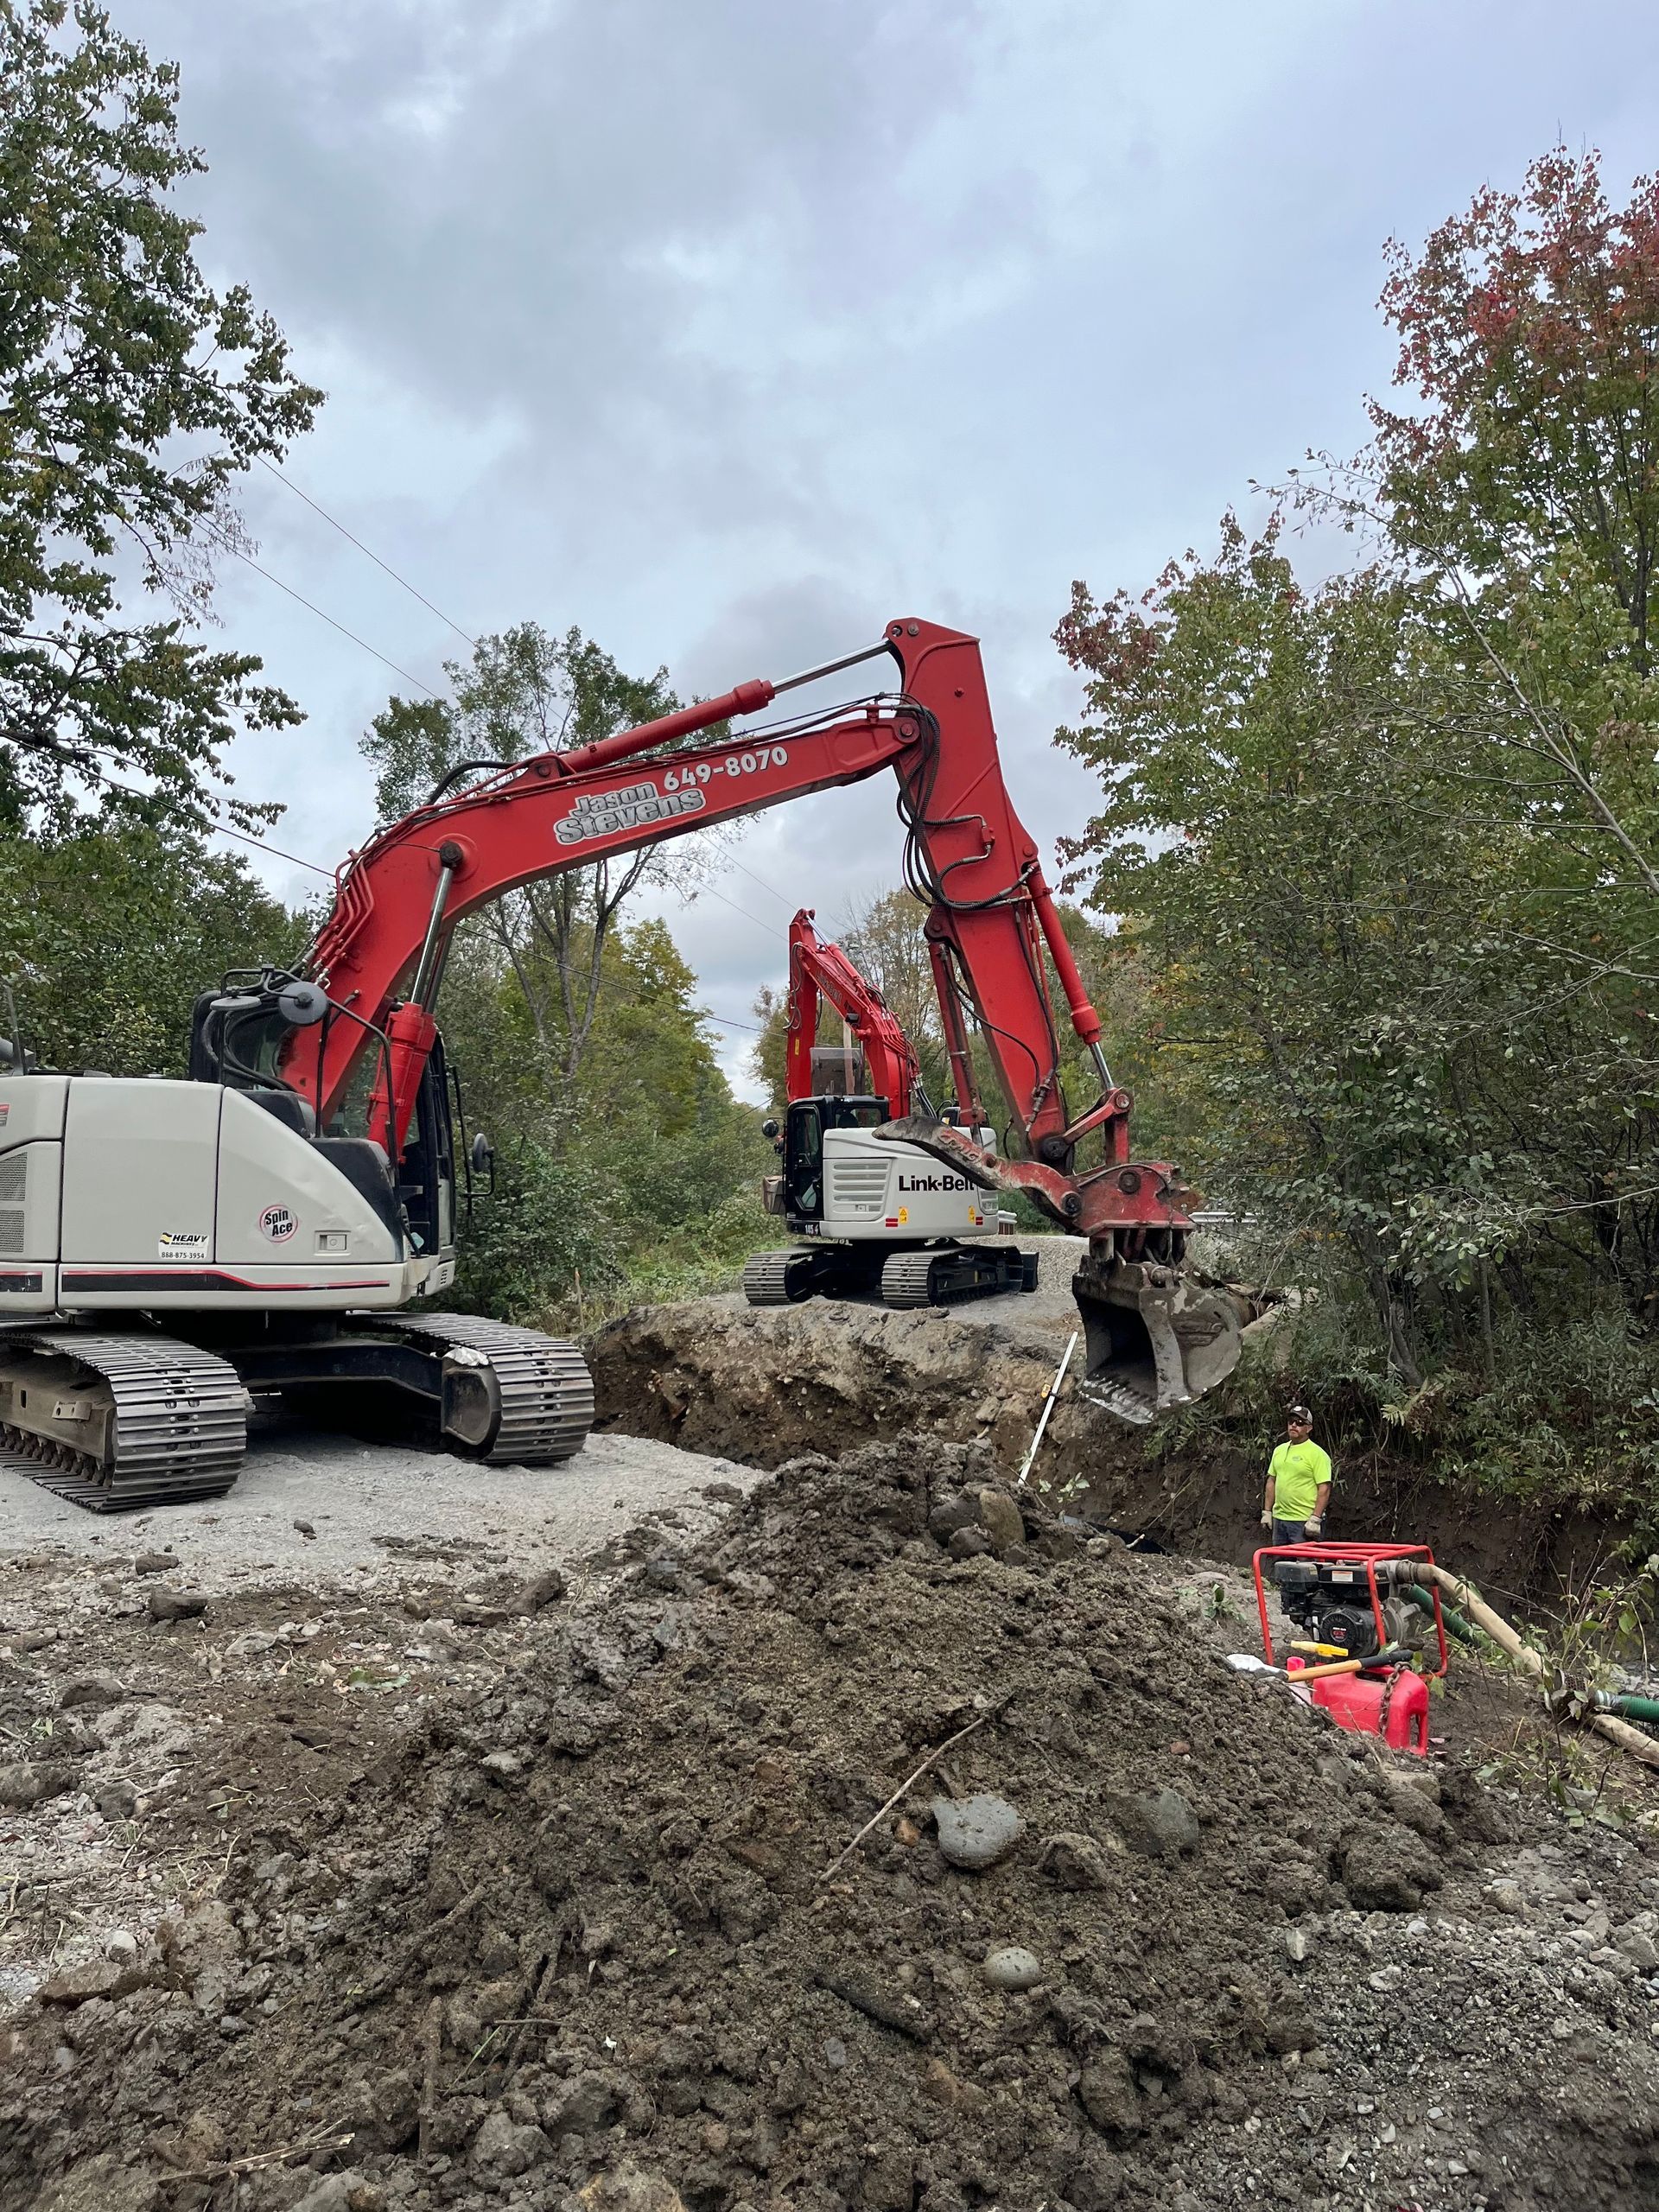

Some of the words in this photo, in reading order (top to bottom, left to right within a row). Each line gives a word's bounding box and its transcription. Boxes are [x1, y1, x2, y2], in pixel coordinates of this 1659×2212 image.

[664, 746, 789, 791] 649-8070
[571, 783, 656, 817] Jason
[556, 789, 704, 844] Stevens
[899, 1175, 975, 1192] Link-Belt
[264, 1210, 289, 1225] Spin
[272, 1223, 293, 1236] Ace
[172, 1234, 208, 1243] HEAVY
